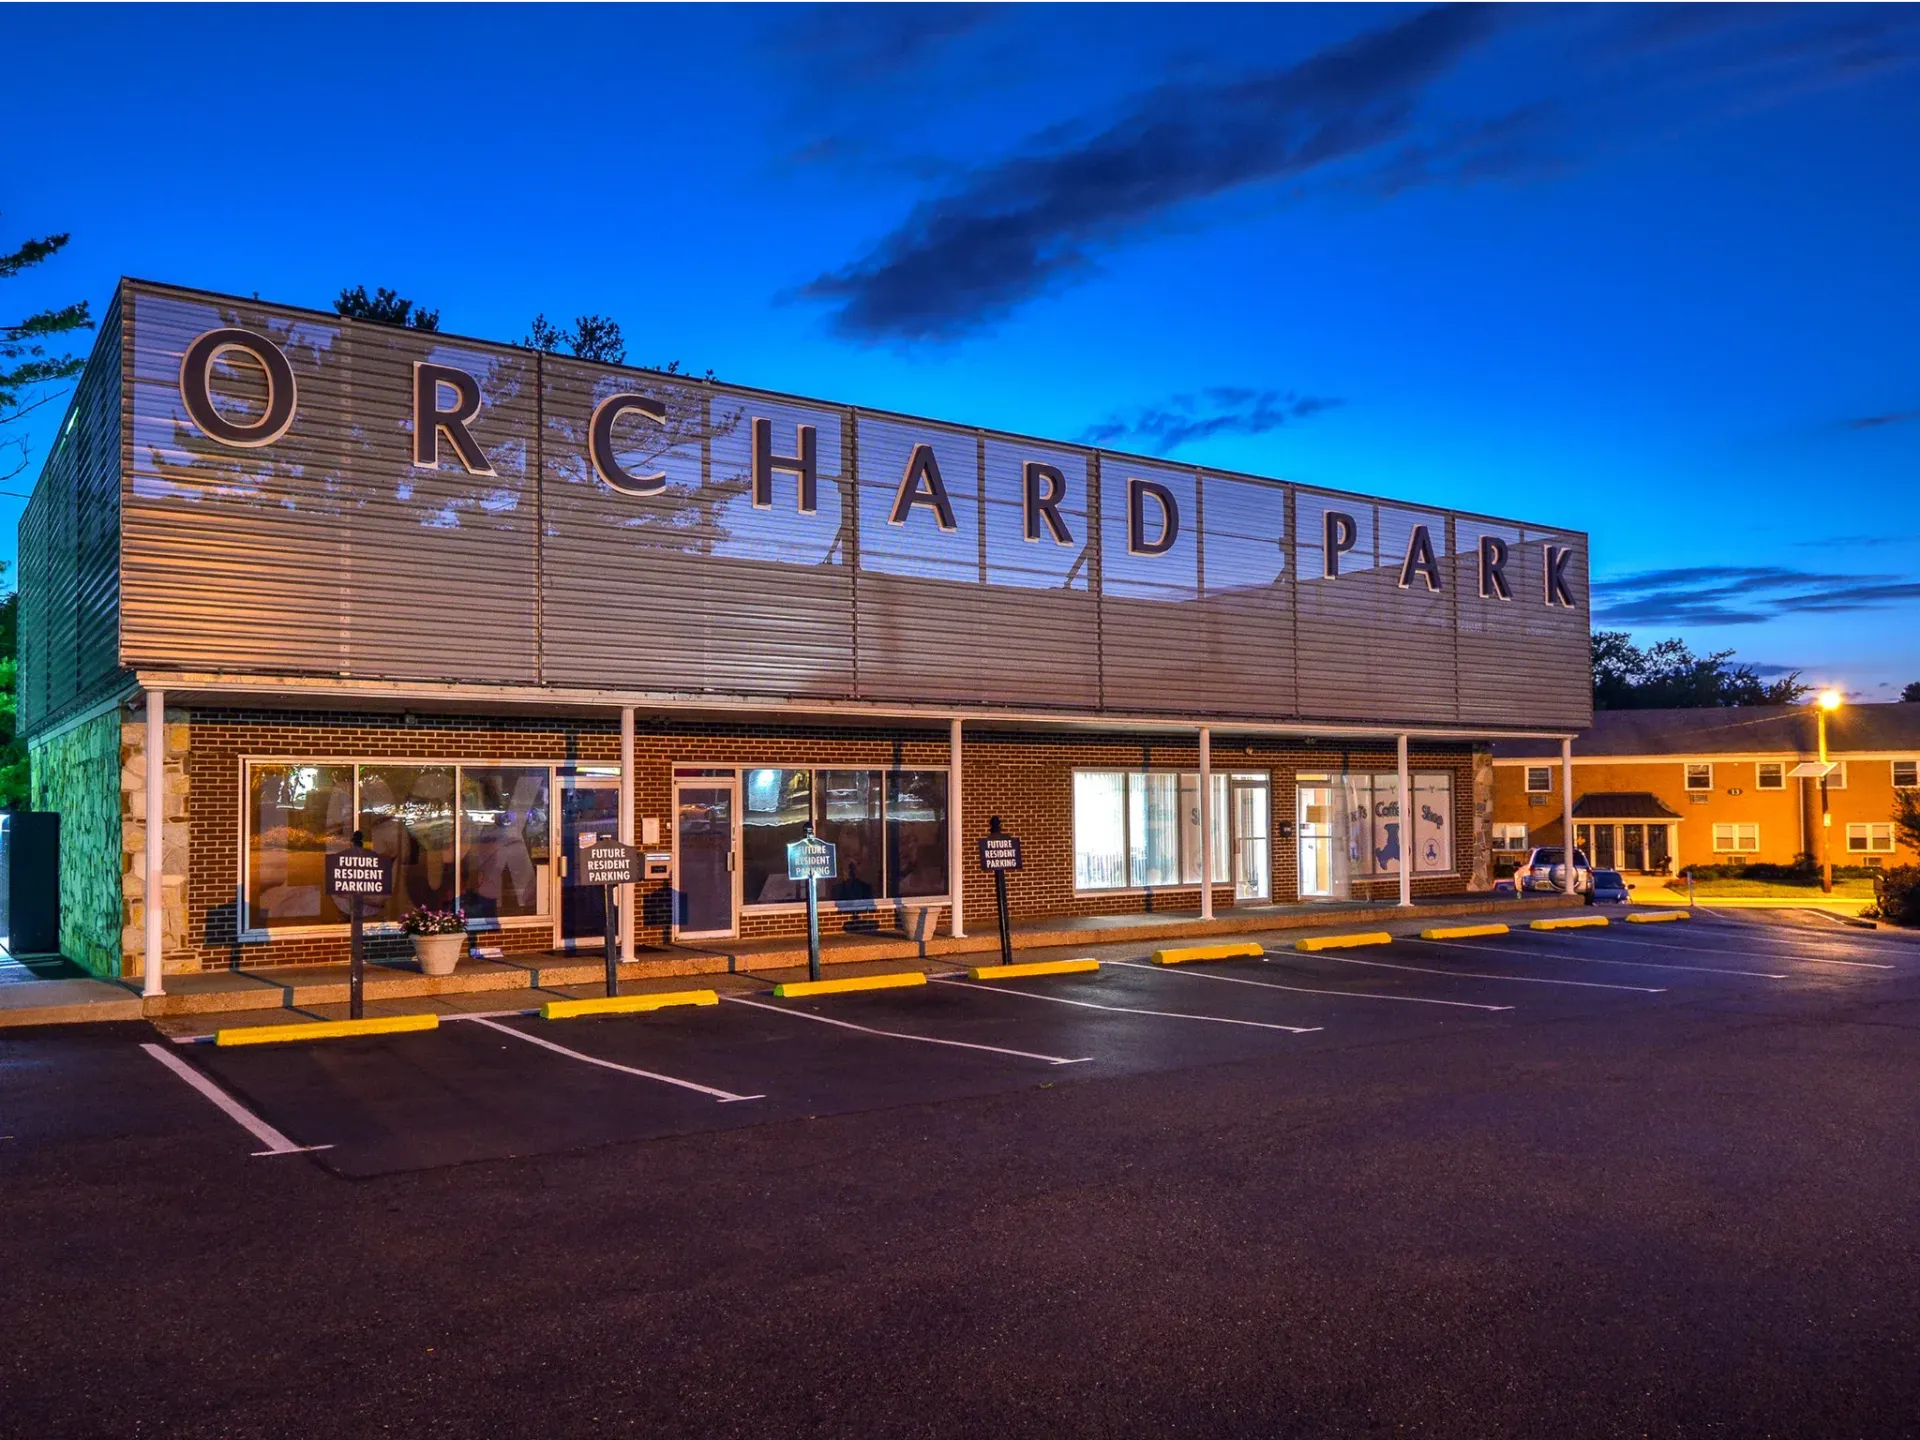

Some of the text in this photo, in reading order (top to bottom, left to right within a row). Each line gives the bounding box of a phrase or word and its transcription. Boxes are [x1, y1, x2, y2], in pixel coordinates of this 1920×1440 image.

[179, 326, 1576, 609] ORCHARD PARK
[986, 840, 1012, 849] FUTURE
[591, 848, 626, 859] FUTURE
[984, 849, 1016, 858] RESIDENT
[339, 856, 379, 868] FUTURE
[587, 859, 630, 871] RESIDENT
[986, 859, 1017, 868] PARKING
[334, 868, 383, 880] RESIDENT
[589, 871, 631, 882] PARKING
[335, 881, 383, 892] PARKING
